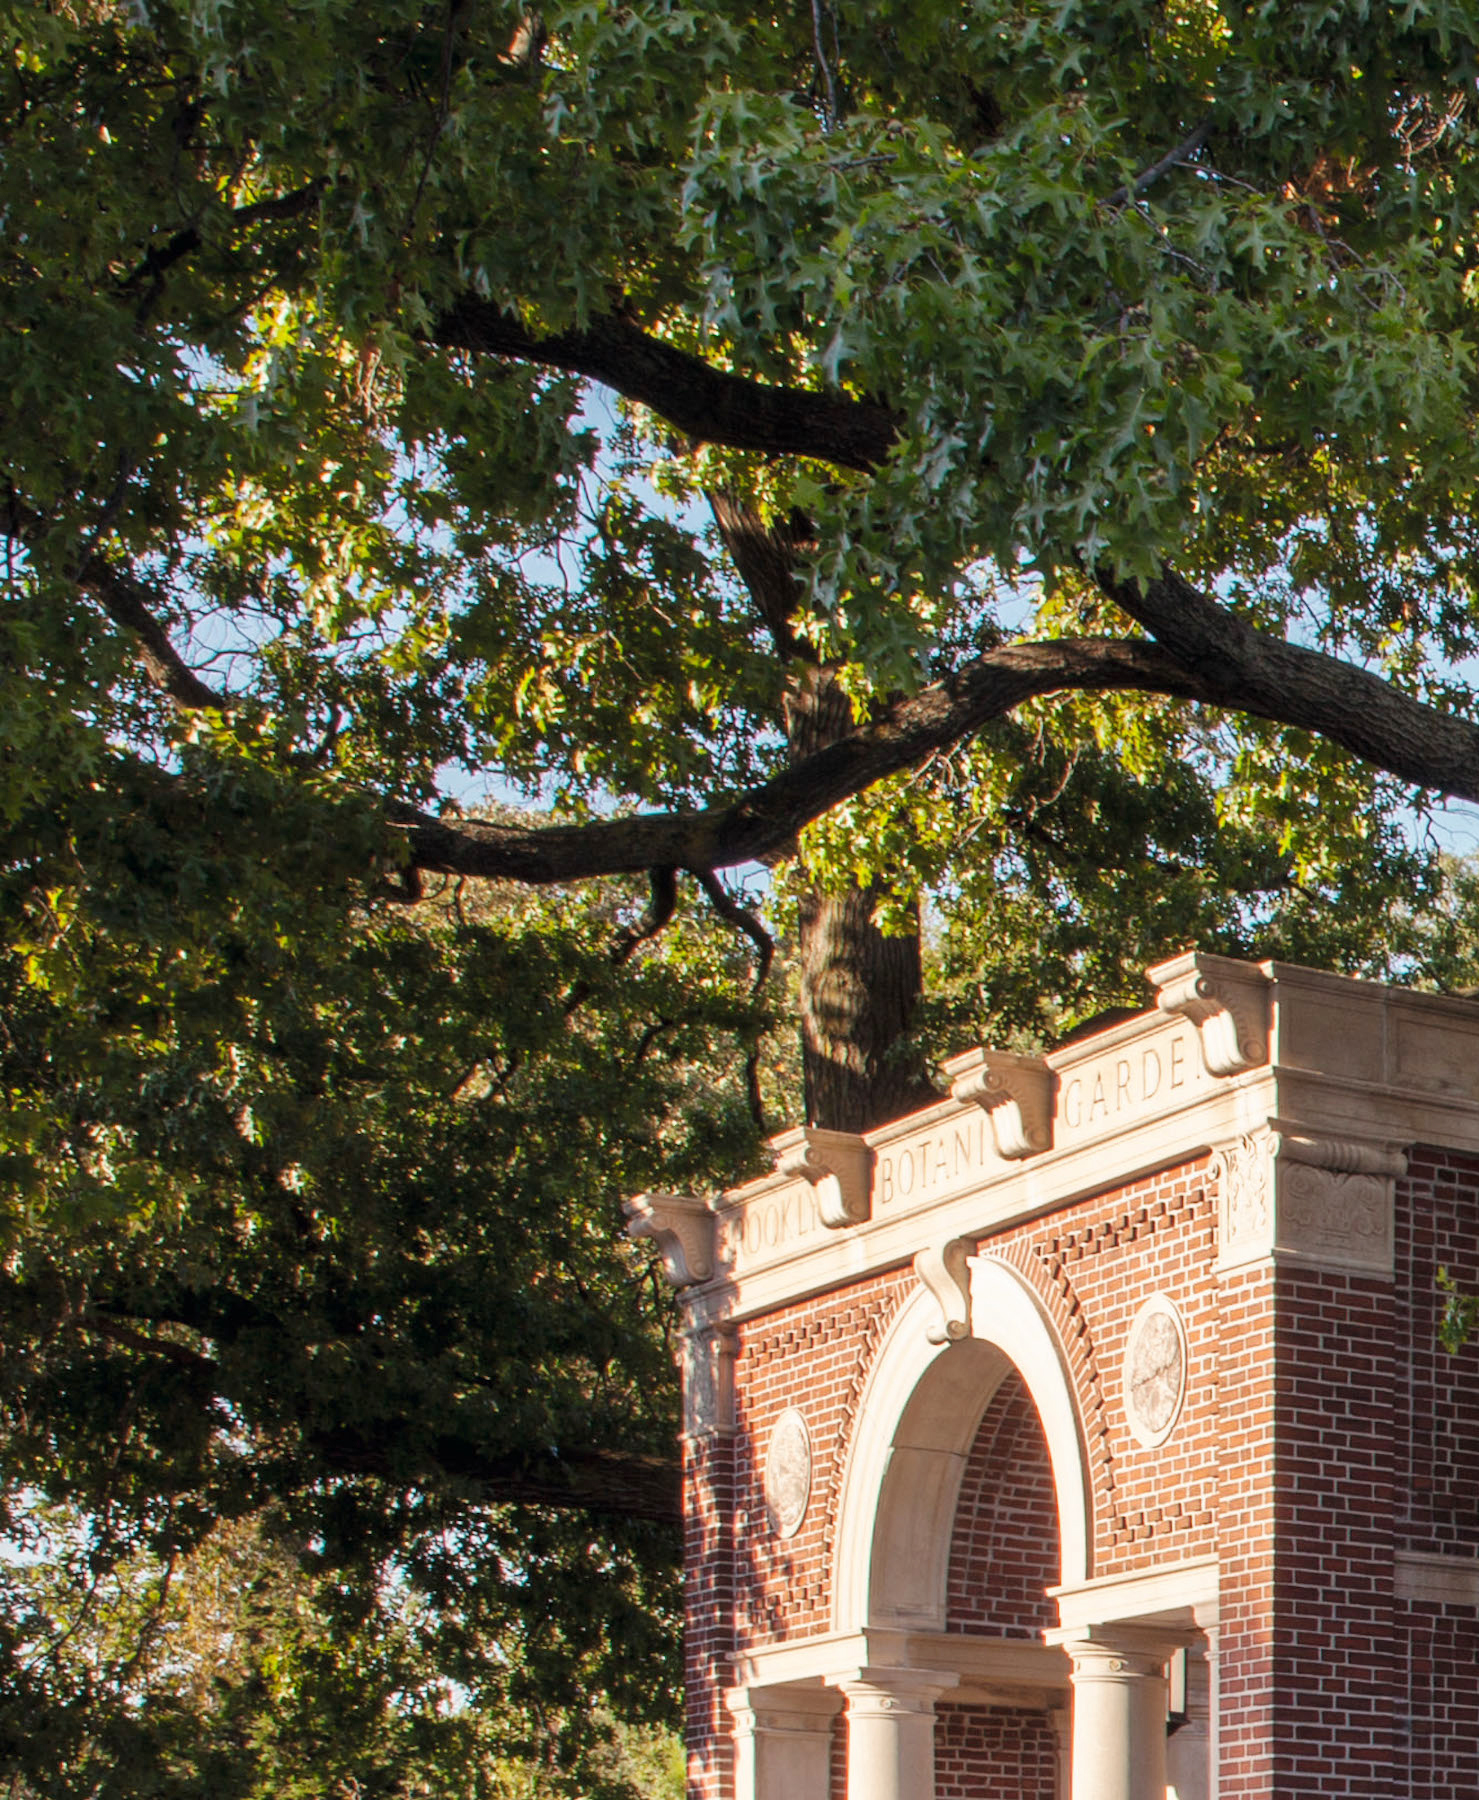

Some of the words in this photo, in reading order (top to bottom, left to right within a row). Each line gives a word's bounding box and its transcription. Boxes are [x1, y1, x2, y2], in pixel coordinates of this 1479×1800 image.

[721, 1187, 818, 1258] ROOKLY
[881, 1119, 985, 1205] BOTANI
[1064, 1035, 1201, 1129] GARDE
